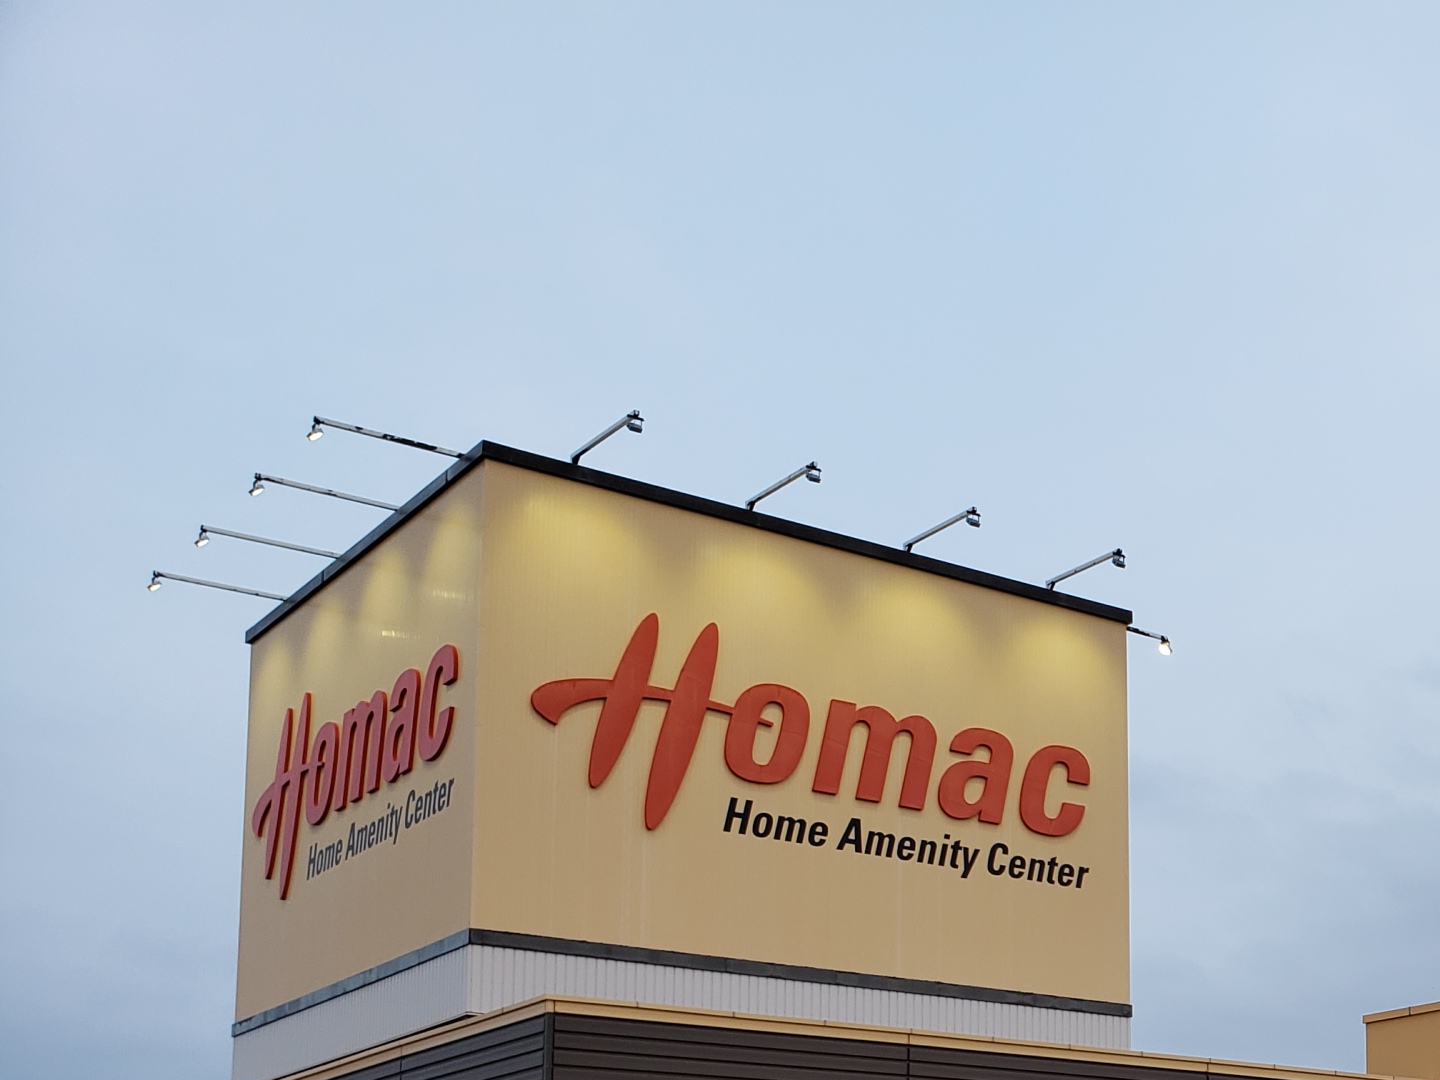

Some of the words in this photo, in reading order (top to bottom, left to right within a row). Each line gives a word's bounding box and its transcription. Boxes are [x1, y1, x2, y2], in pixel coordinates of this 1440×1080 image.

[252, 643, 460, 901] Homac
[530, 612, 1091, 837] Homac
[307, 839, 343, 881] Home
[345, 803, 403, 861] Amenity
[404, 777, 455, 829] Center
[723, 797, 828, 849] Home
[837, 817, 982, 880] Amenity
[986, 843, 1090, 891] Center
